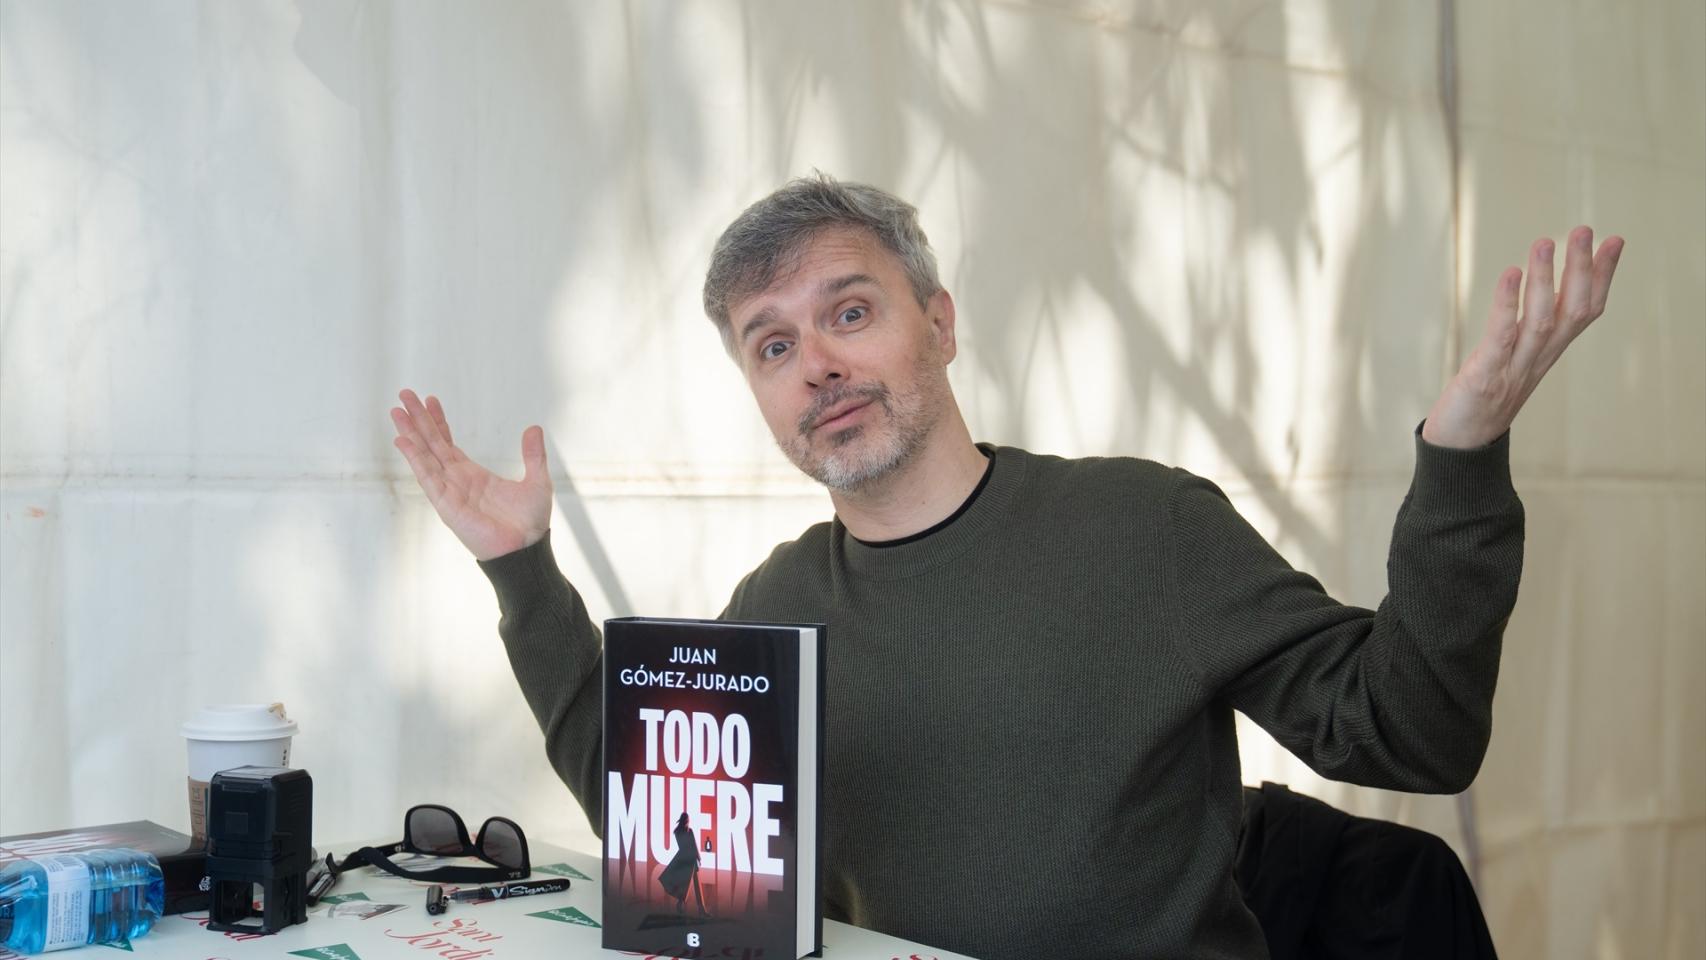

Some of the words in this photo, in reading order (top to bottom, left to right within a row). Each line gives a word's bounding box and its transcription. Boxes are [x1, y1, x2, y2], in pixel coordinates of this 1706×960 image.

[669, 647, 716, 664] JUAN
[620, 664, 769, 693] GÓMEZ-JURADO
[639, 708, 750, 778] TODO
[608, 771, 784, 876] MUERE
[433, 919, 503, 942] Sant
